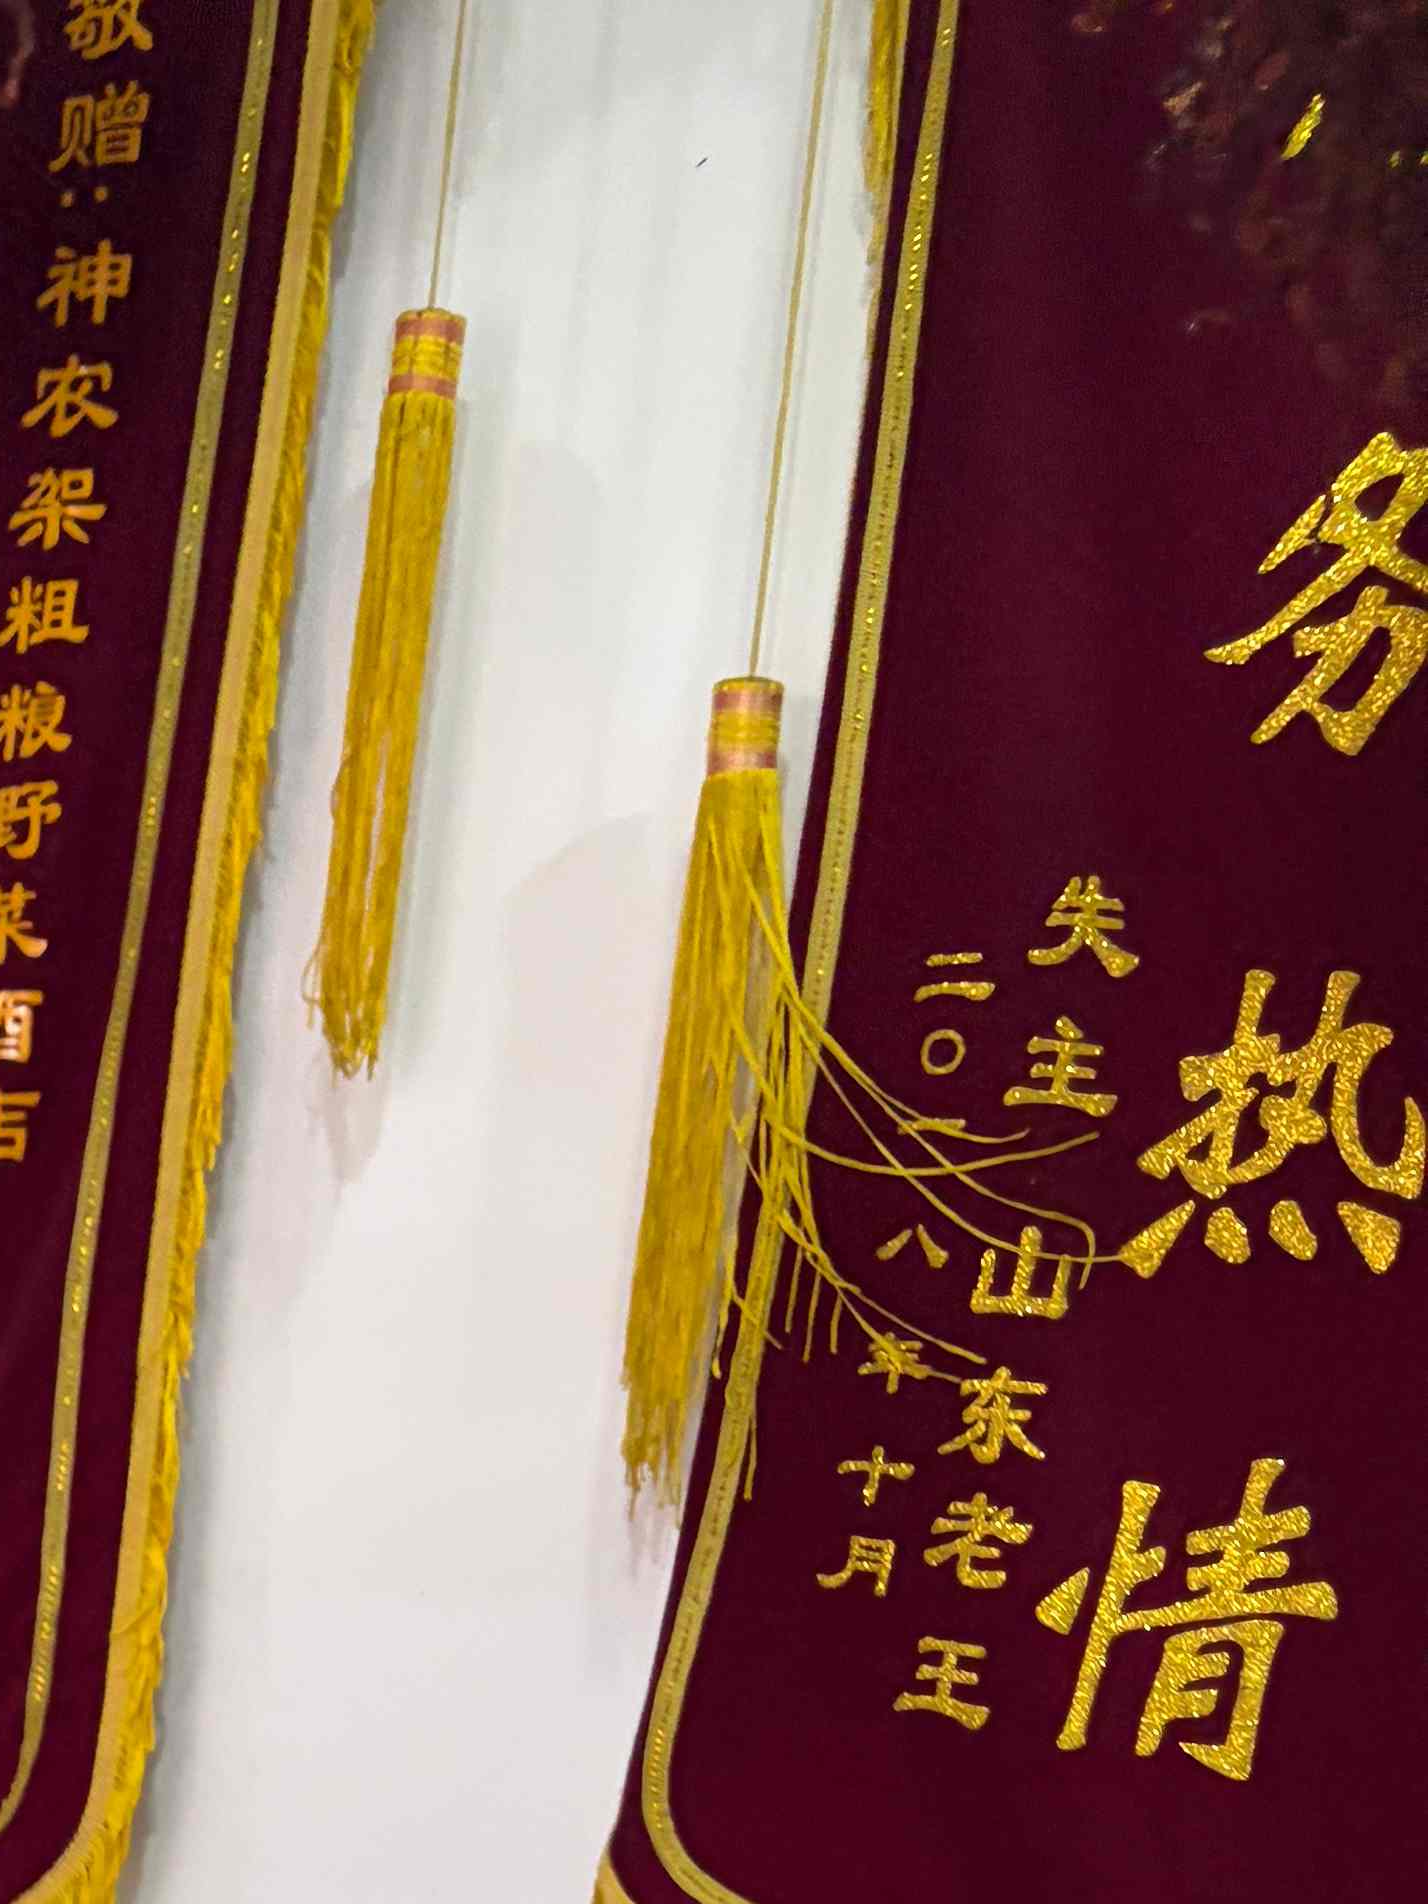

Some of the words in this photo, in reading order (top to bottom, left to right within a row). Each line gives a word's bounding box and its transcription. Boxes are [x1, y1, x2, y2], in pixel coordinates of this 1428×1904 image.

[891, 874, 1141, 1731] 失主山东老王
[1032, 430, 1428, 1783] 务热情
